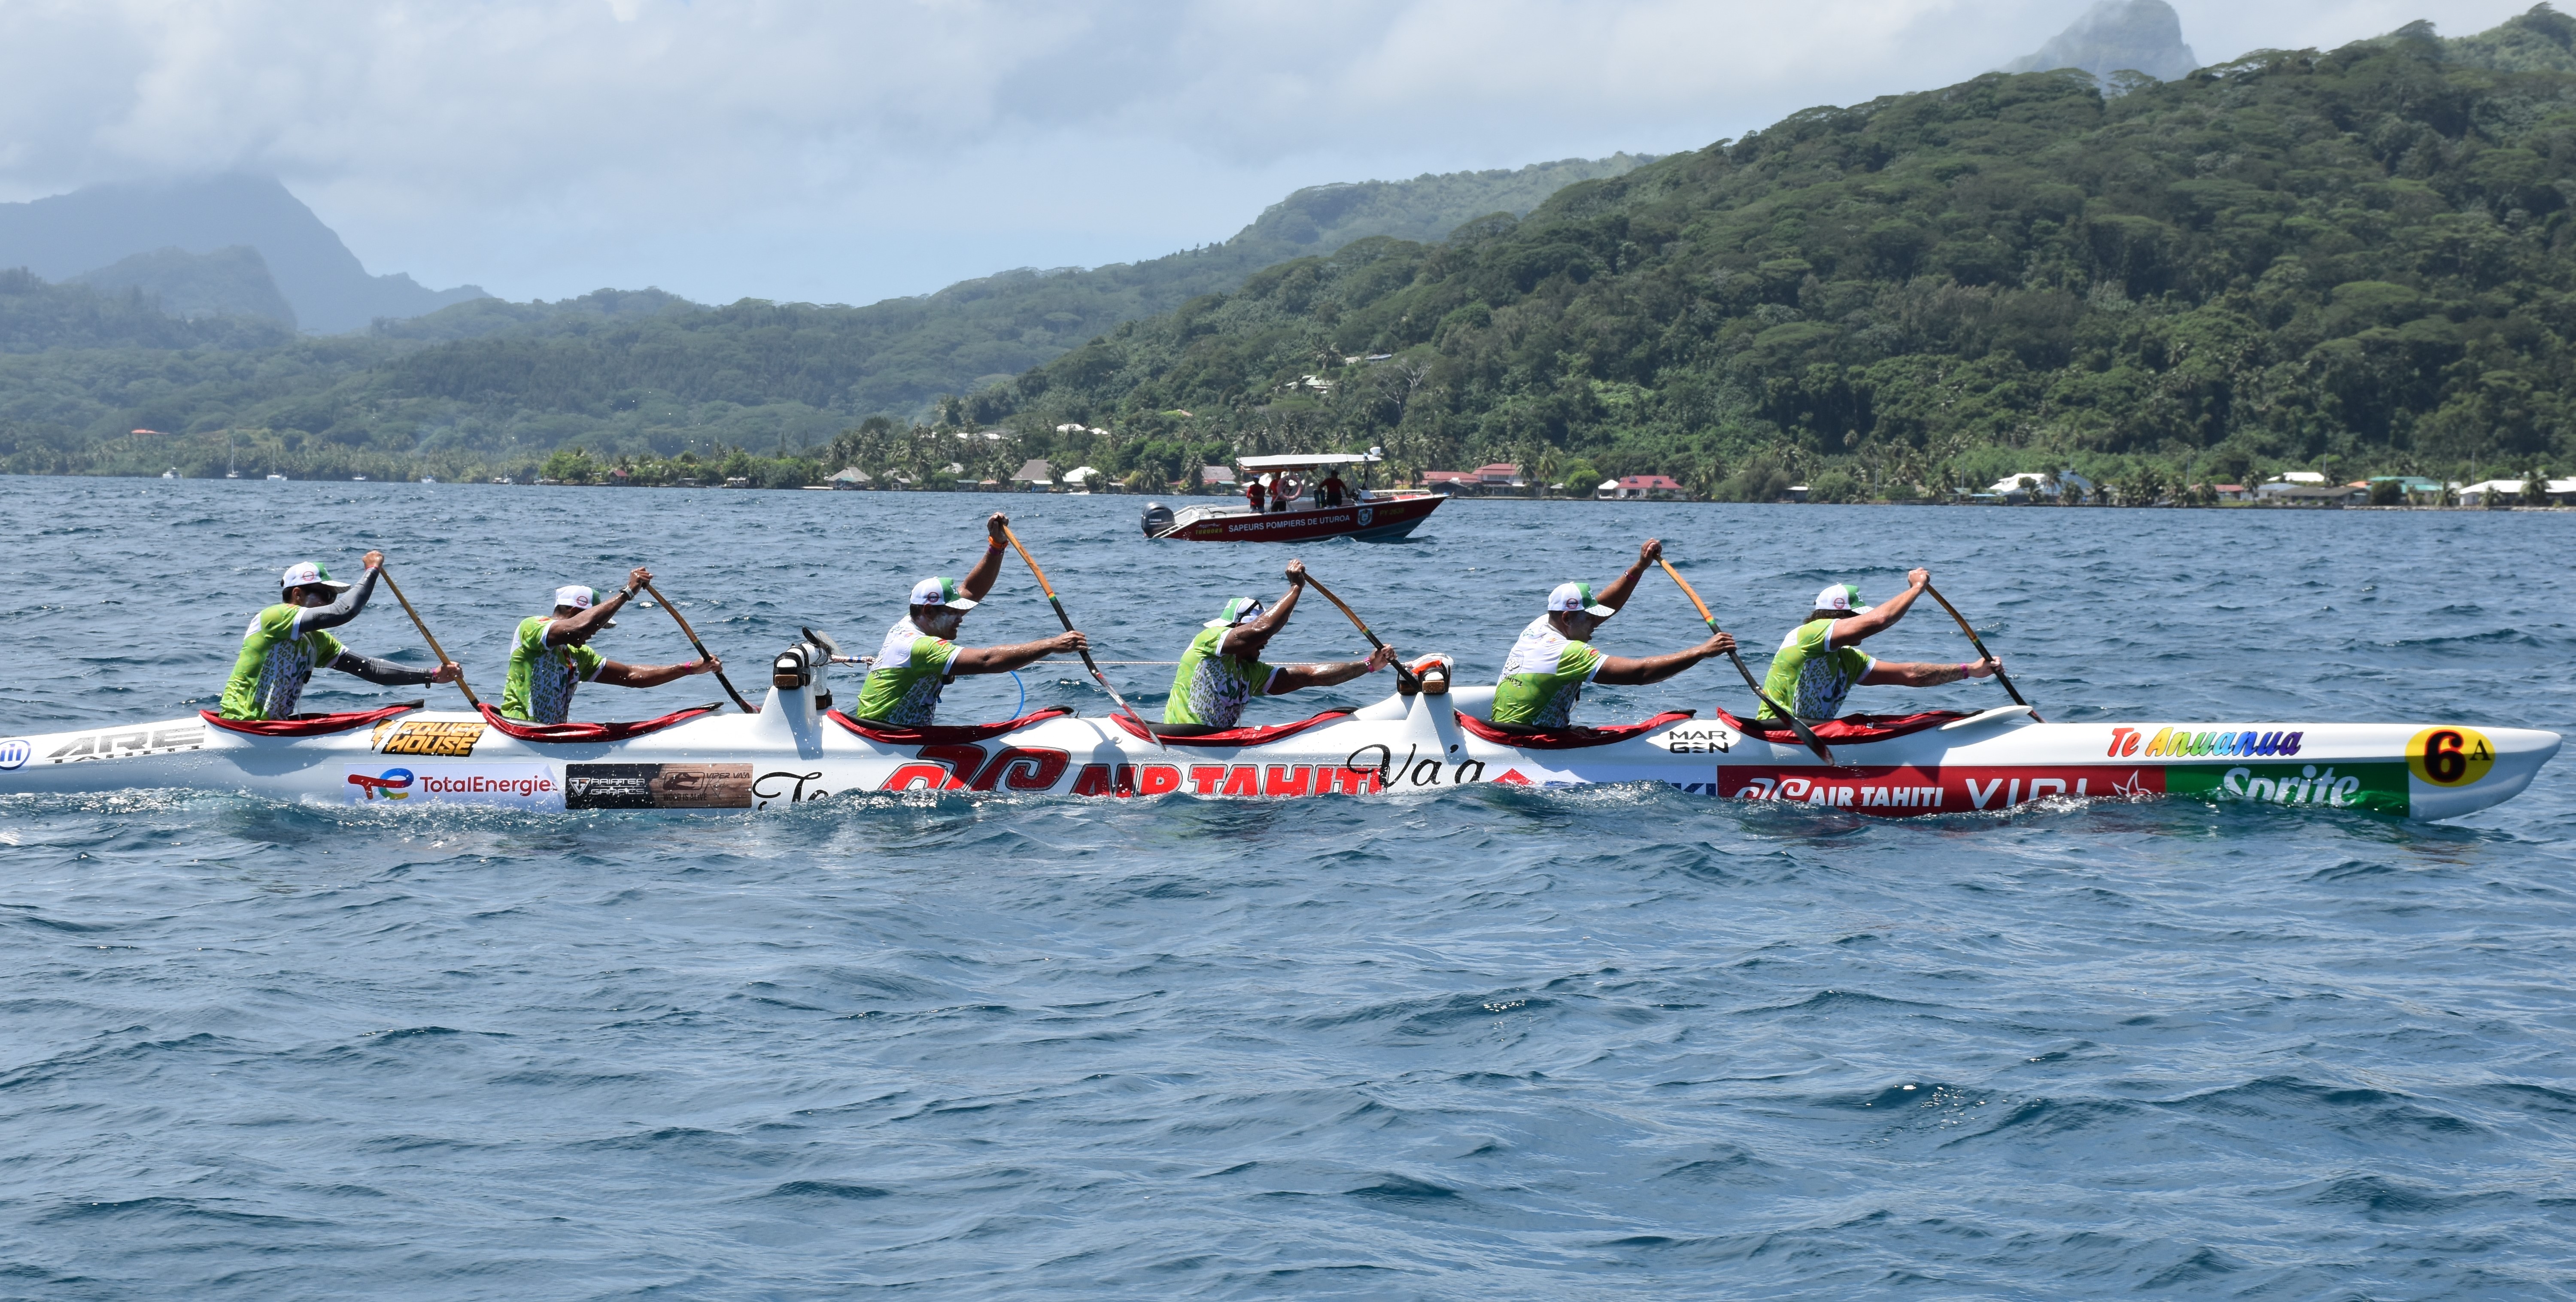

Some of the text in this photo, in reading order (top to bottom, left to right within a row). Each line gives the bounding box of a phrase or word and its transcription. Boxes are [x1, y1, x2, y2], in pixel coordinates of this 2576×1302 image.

[1229, 523, 1264, 532] SAPEURS
[1267, 519, 1306, 529] POMPIERS
[1319, 515, 1350, 524] UTUROA
[398, 722, 487, 737] POWER
[1669, 731, 1727, 740] MAR
[46, 725, 206, 758] ARE
[385, 735, 477, 754] HOUSE
[2107, 727, 2304, 757] Te Anuanua
[1347, 743, 1486, 788] Va'a
[2424, 729, 2492, 783] 6 A
[419, 775, 558, 797] TotalEnergies
[1188, 763, 1391, 798] TAHITI
[2224, 765, 2360, 806] Sprite
[663, 793, 682, 801] WOOD
[1809, 786, 1944, 807] AIR TAHITI
